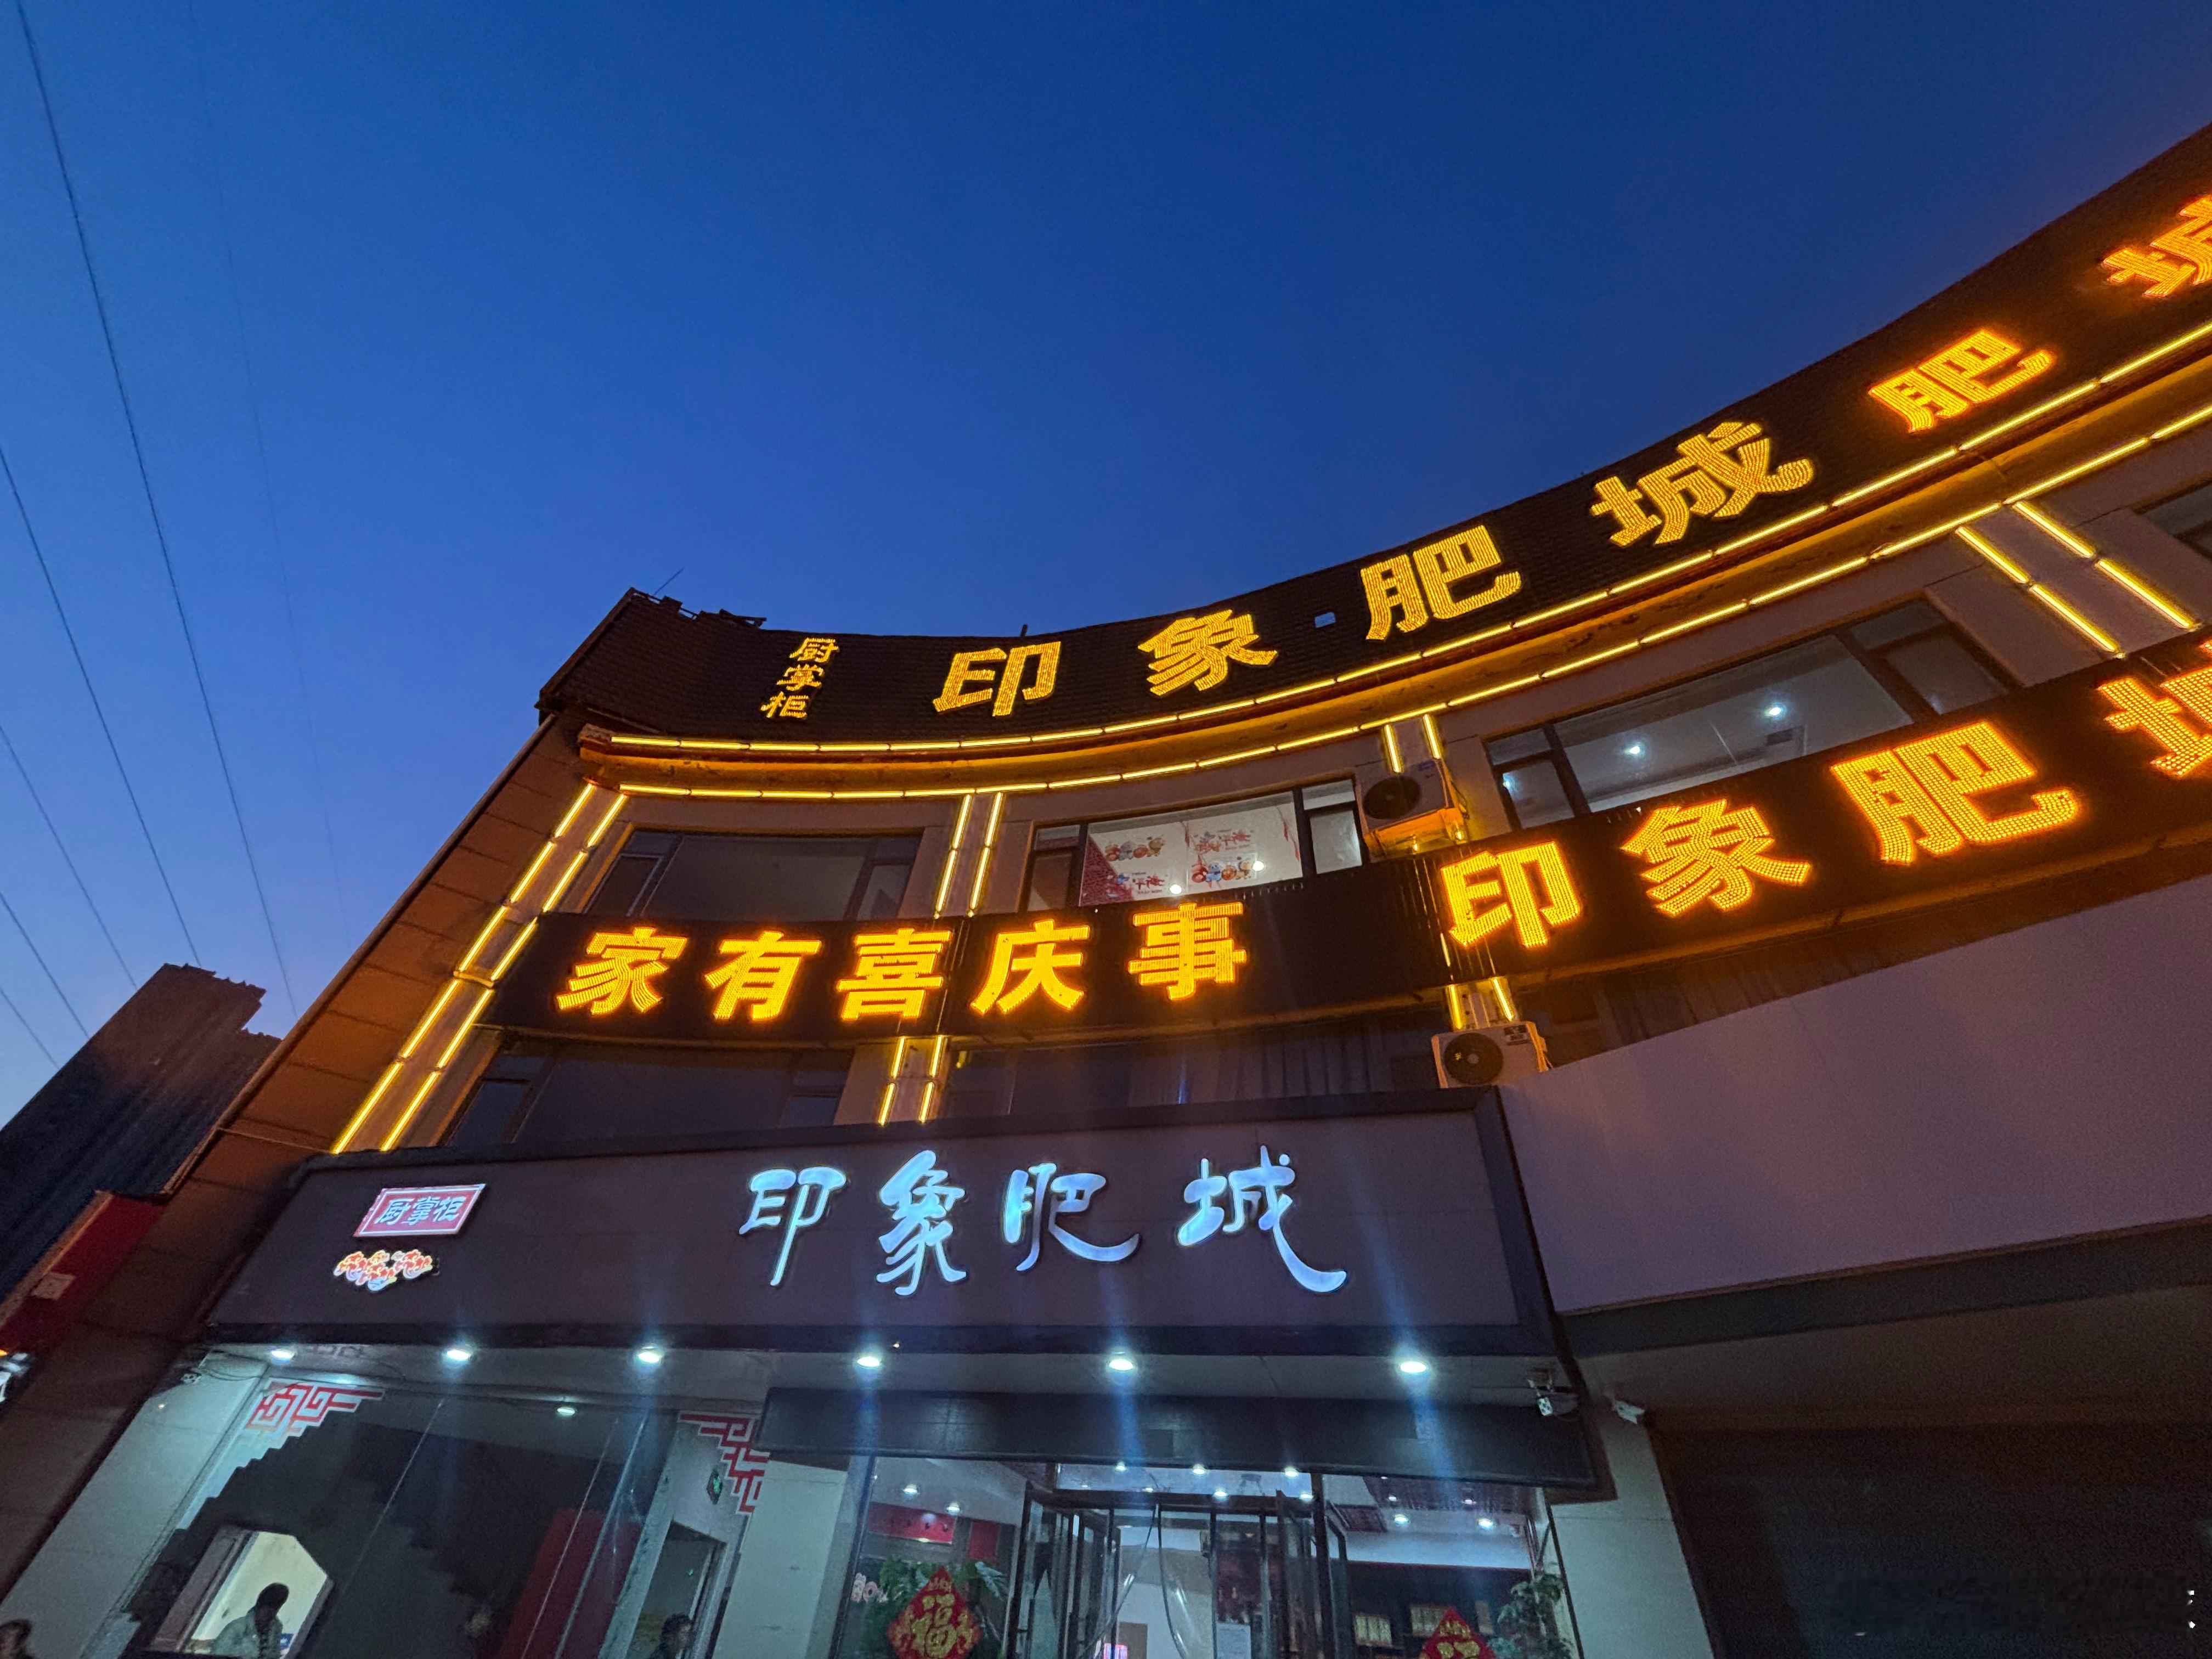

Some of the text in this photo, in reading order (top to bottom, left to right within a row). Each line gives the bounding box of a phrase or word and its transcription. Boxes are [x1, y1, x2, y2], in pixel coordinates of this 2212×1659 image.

[760, 637, 839, 718] 厨掌柜
[556, 901, 1248, 1022] 家有喜庆事
[374, 1196, 466, 1226] 厨掌柜
[738, 1146, 1347, 1296] 印象肥城
